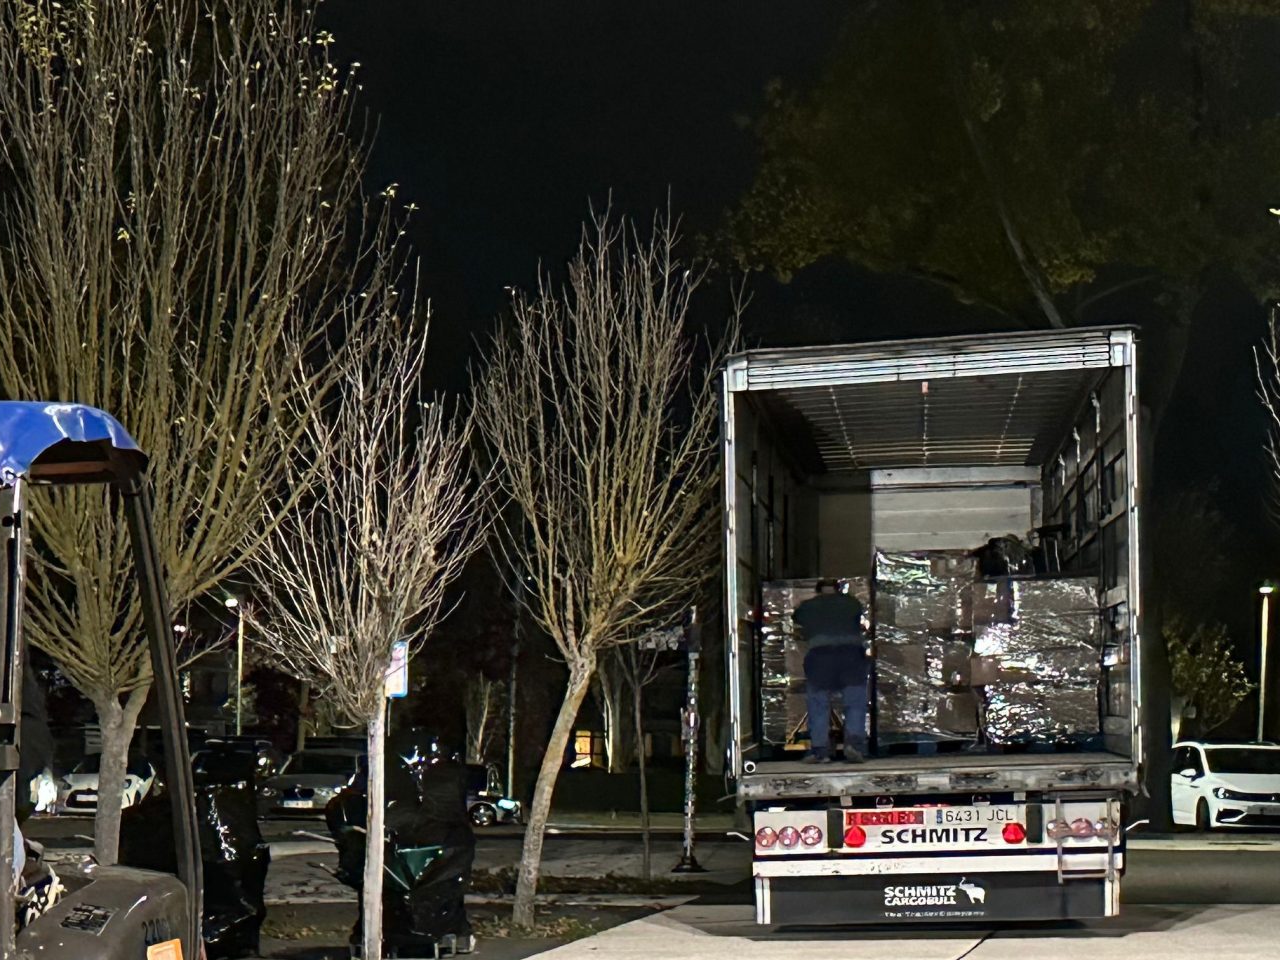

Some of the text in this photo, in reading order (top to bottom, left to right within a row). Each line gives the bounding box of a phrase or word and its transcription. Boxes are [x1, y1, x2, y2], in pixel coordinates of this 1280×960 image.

[945, 808, 1014, 823] 6431 JCL
[881, 827, 988, 844] SCHMITZ
[884, 885, 957, 897] SCHMITZ
[884, 896, 957, 906] CARGOBULL
